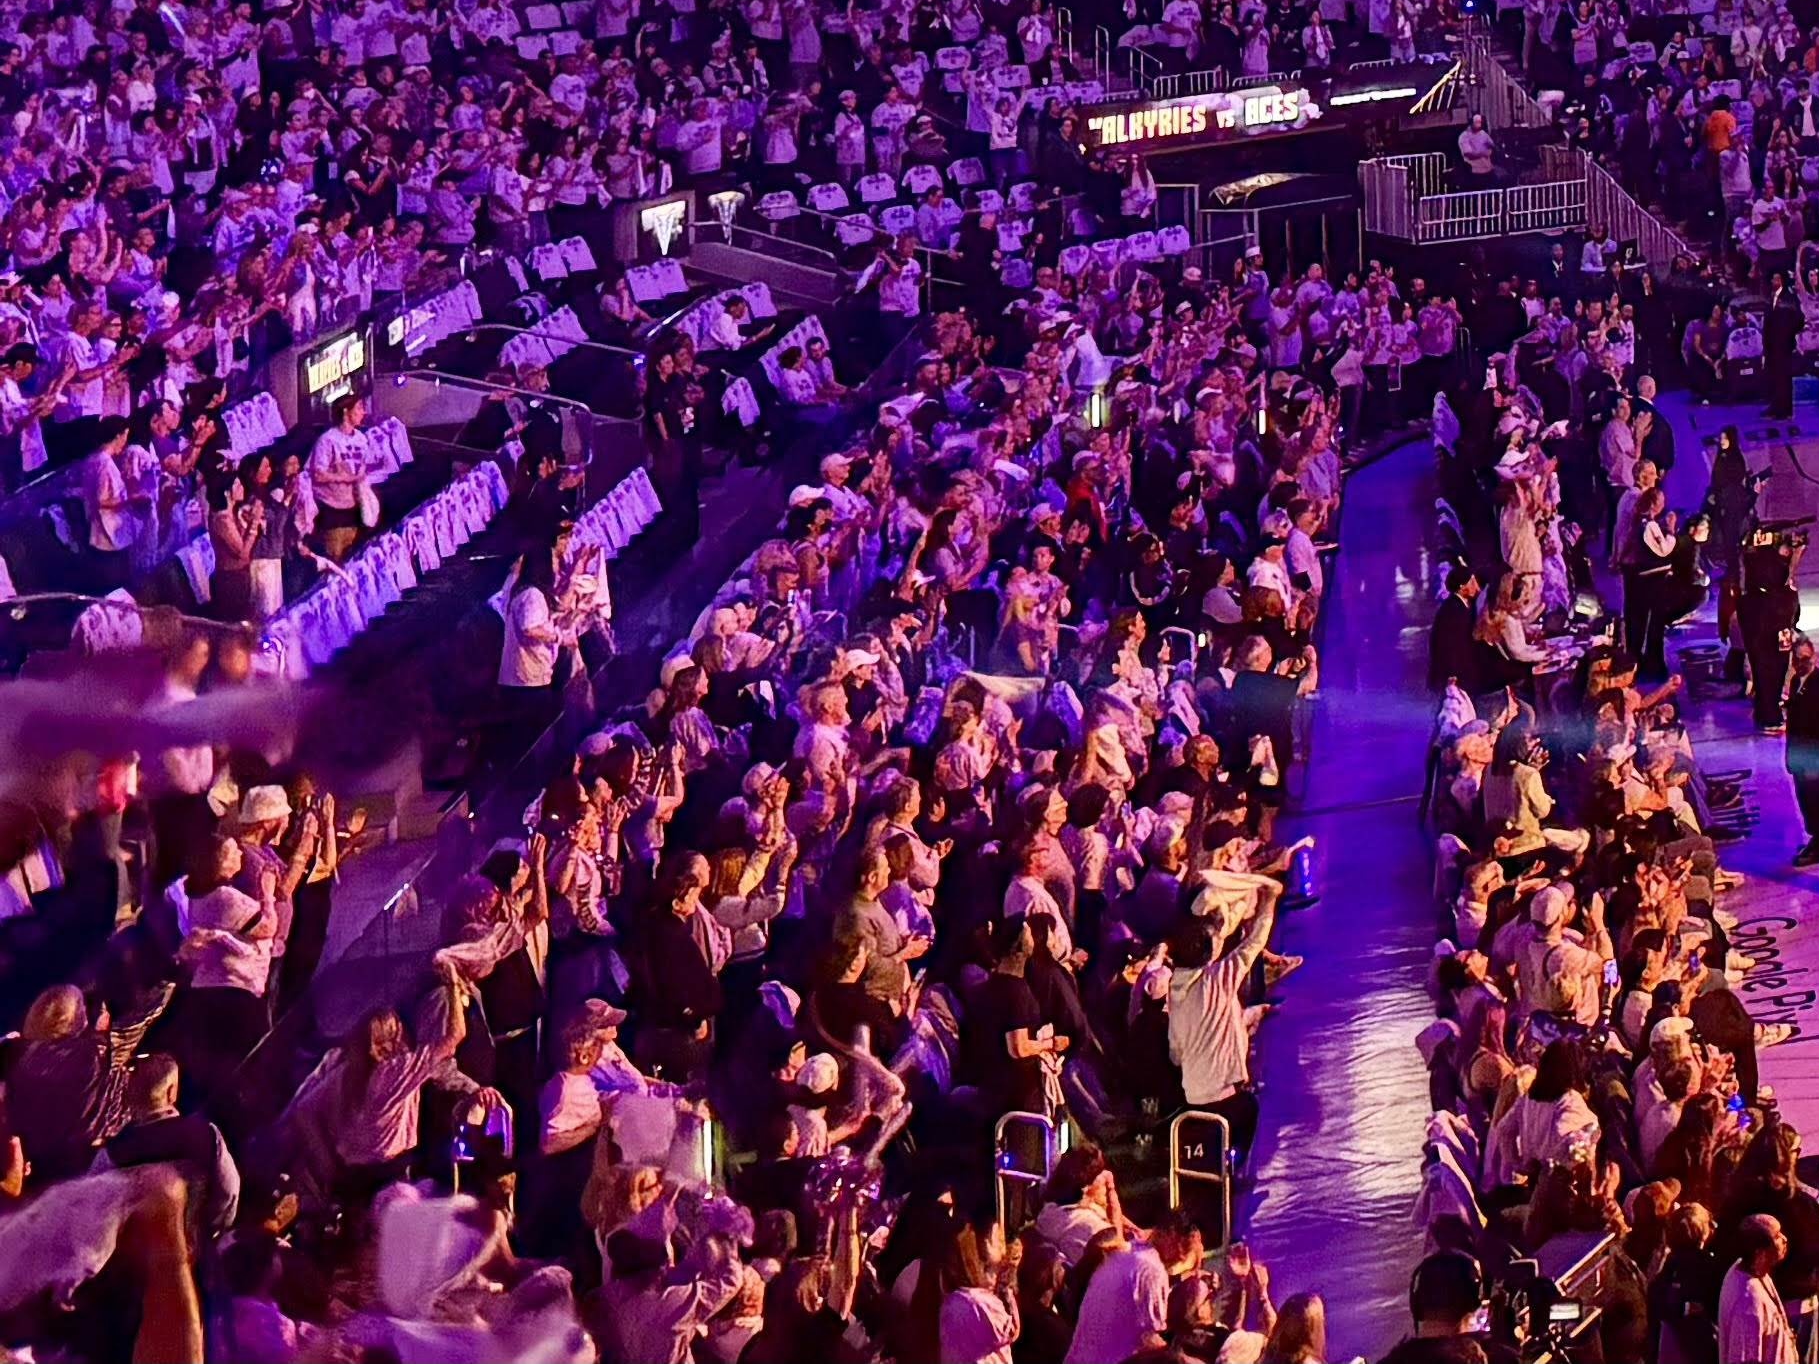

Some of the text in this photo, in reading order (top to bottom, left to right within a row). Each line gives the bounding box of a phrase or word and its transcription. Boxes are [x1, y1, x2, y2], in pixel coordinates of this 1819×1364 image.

[1245, 92, 1299, 127] ACES
[1729, 916, 1809, 992] Google
[1183, 1142, 1205, 1160] 14
